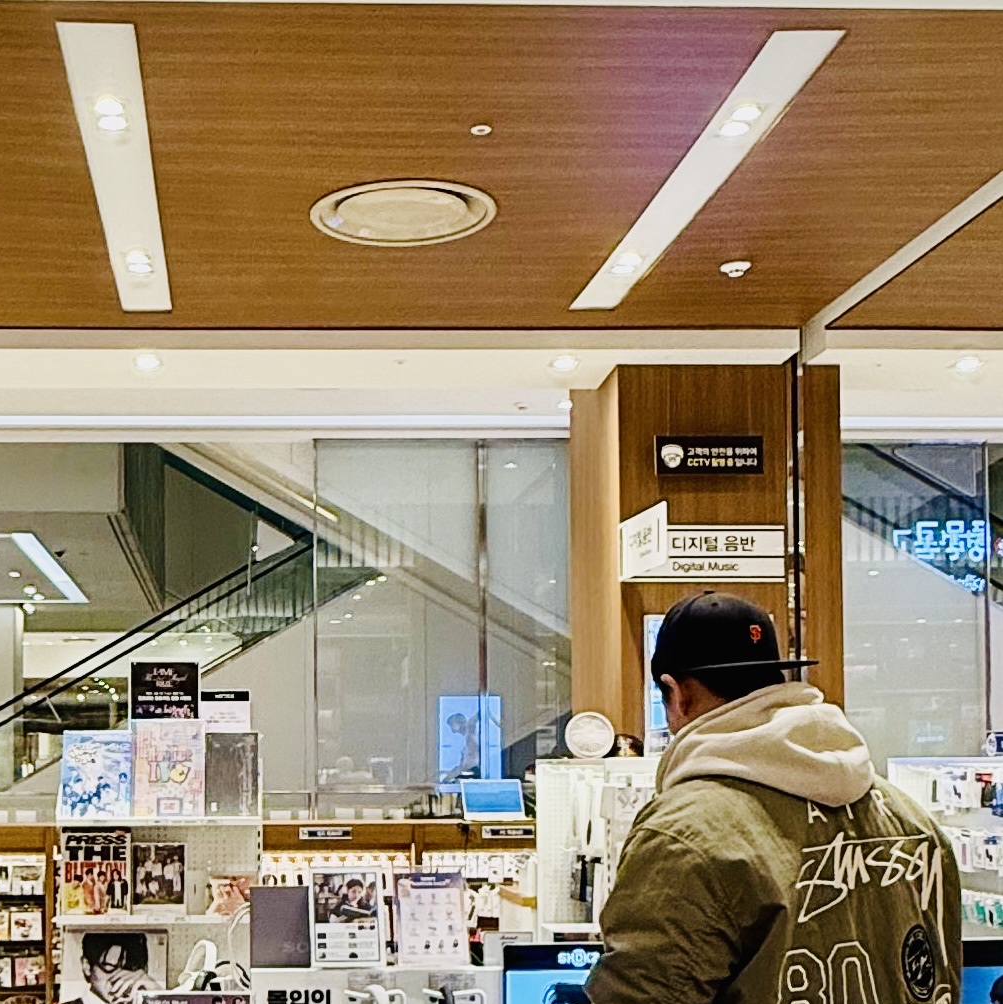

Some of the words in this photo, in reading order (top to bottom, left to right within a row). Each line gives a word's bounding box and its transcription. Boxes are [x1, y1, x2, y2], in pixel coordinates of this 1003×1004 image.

[687, 458, 709, 467] CCTV
[672, 536, 718, 552] 디지털
[724, 536, 755, 552] 음반
[672, 561, 705, 573] Digital
[708, 561, 739, 572] Music
[807, 789, 893, 824] AIR
[65, 835, 127, 846] PRESS
[65, 846, 127, 861] THE
